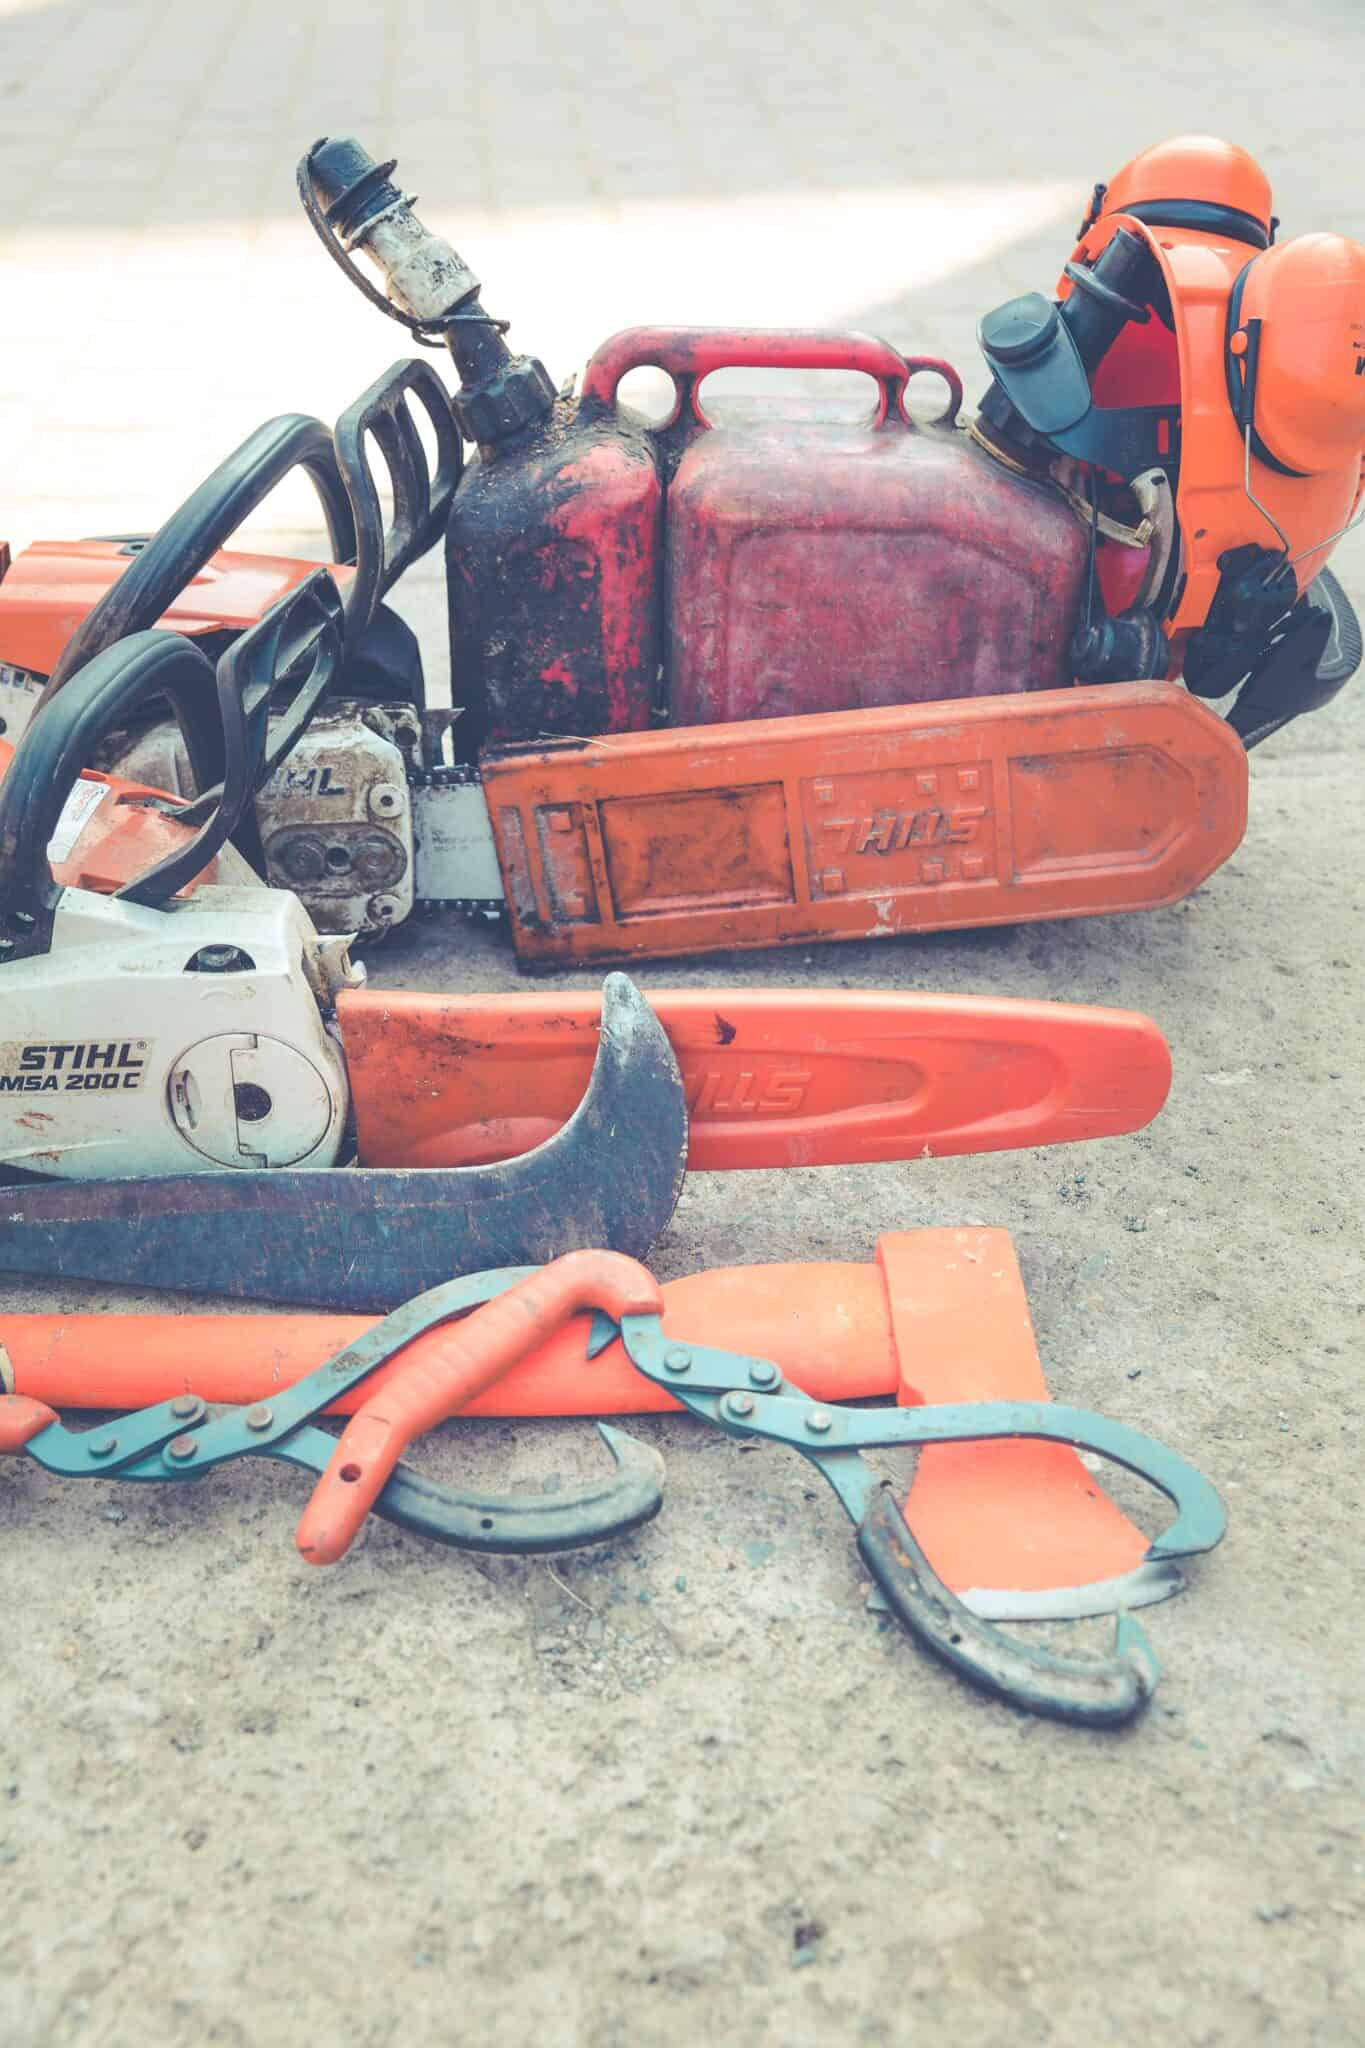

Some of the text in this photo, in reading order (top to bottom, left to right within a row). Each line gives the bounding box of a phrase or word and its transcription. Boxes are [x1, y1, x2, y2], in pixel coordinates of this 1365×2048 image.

[0, 1072, 140, 1091] MSA 200 C
